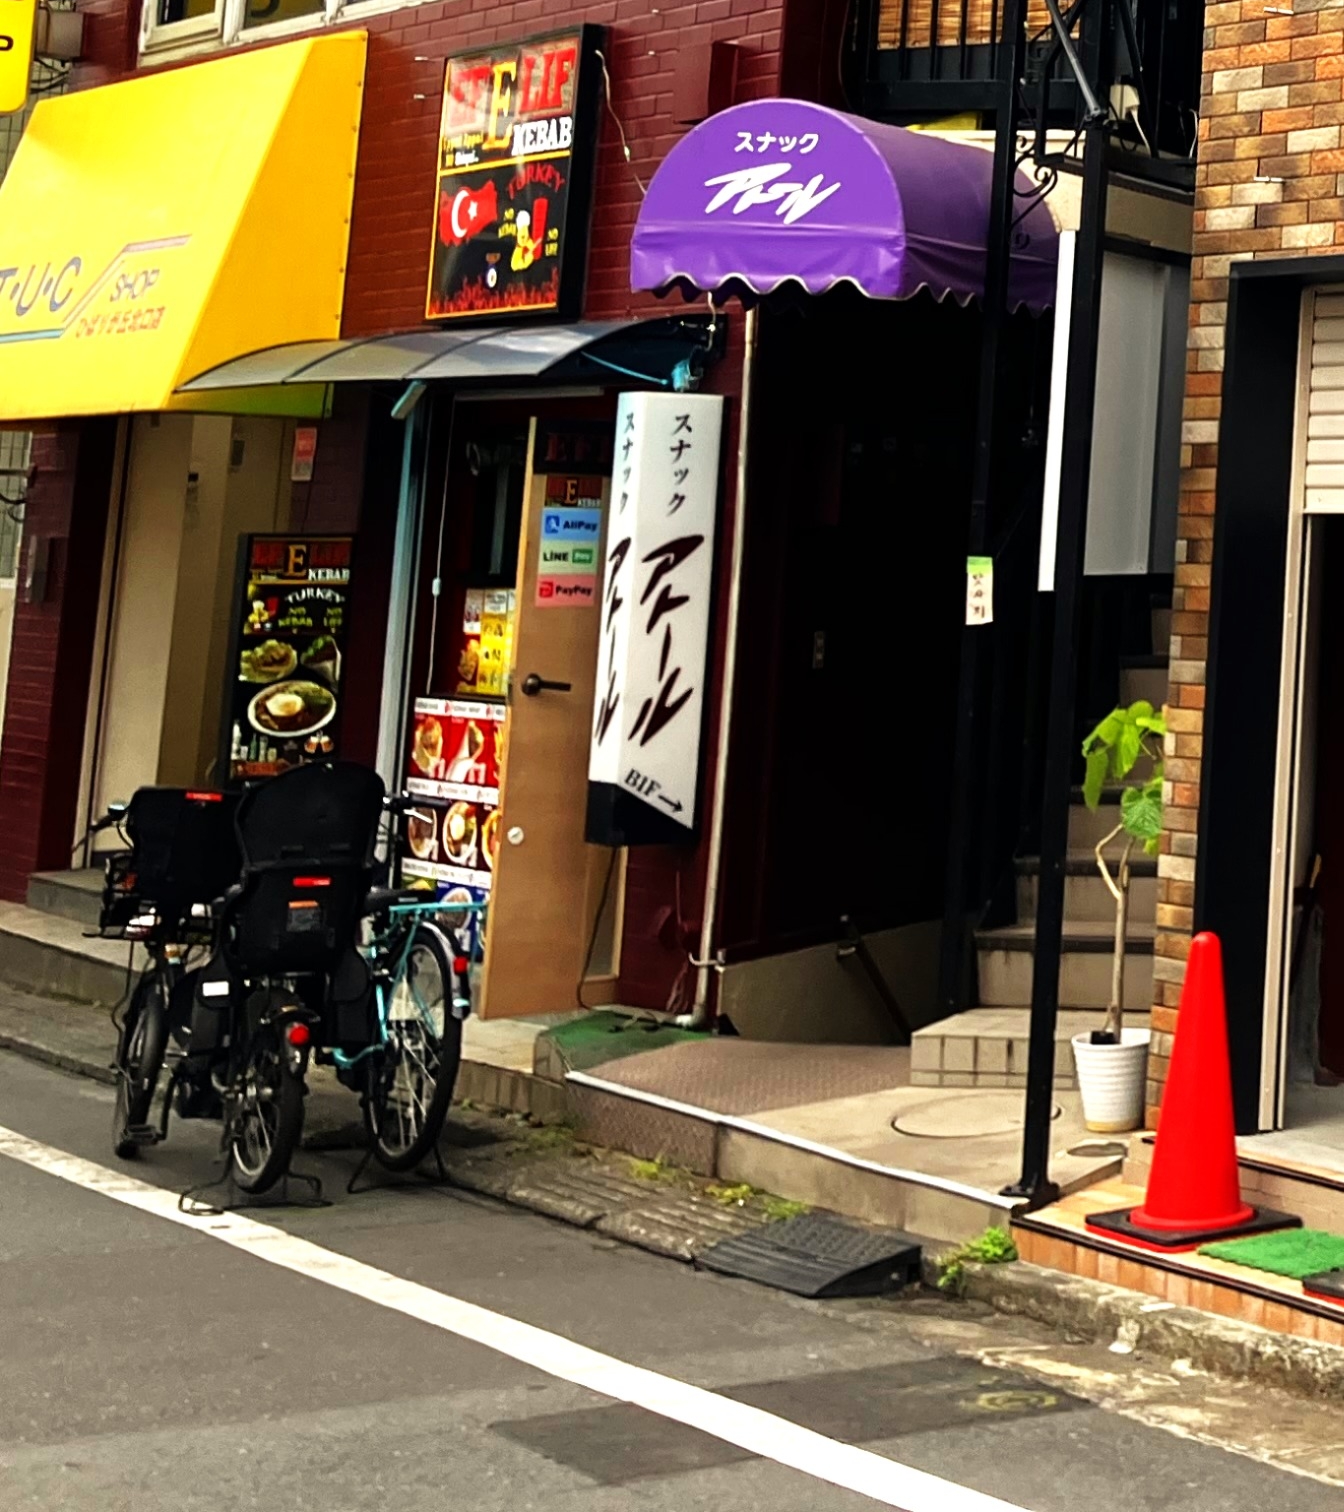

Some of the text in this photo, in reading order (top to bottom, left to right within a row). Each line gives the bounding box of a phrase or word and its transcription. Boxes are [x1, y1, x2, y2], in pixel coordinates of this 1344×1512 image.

[511, 116, 573, 156] KEBAB
[734, 131, 819, 154] スナック
[507, 162, 565, 200] TURKEY
[619, 412, 635, 515] スナック
[668, 413, 693, 516] スナック
[563, 519, 598, 532] AliPay
[543, 551, 568, 562] LINE
[308, 568, 350, 581] KEBAB
[285, 587, 345, 603] TURKEY
[556, 584, 592, 597] PayPay
[628, 535, 704, 748] アトール
